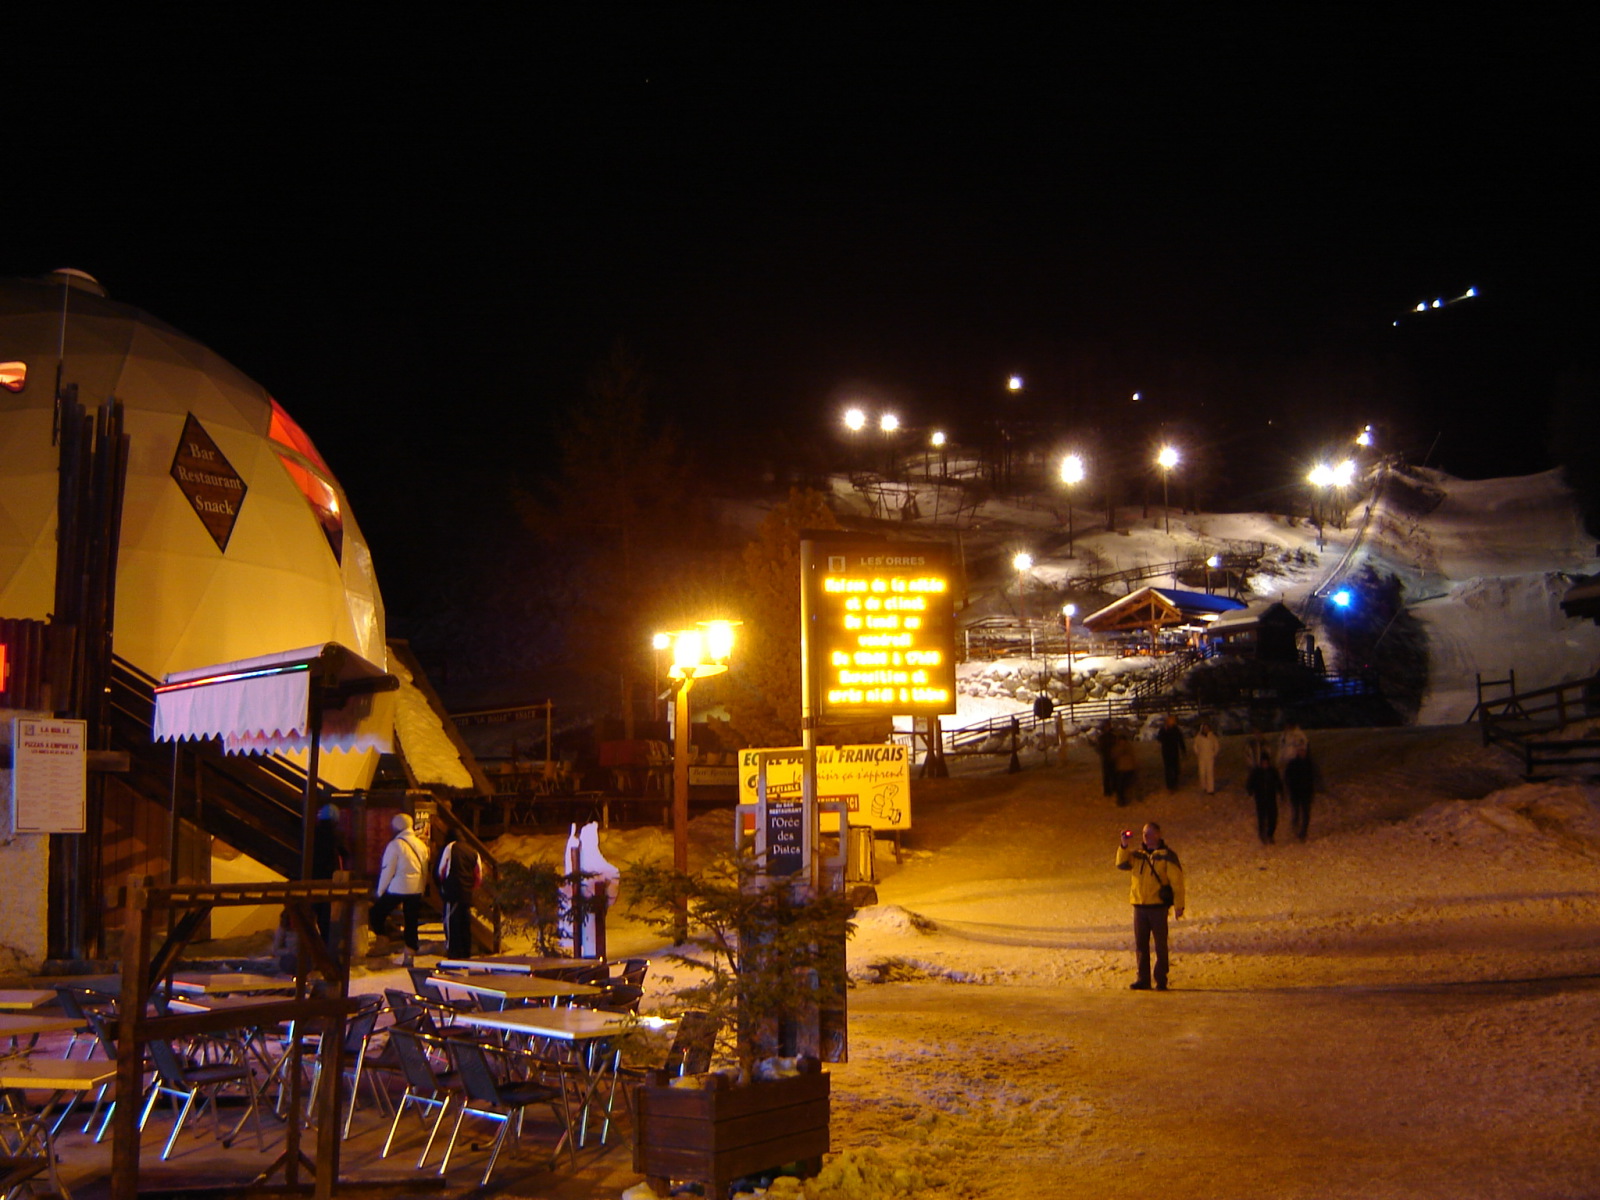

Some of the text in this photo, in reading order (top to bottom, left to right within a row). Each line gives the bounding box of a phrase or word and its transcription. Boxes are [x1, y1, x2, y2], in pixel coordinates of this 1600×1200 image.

[188, 442, 215, 461] Bar
[178, 465, 242, 490] Restaurant
[195, 495, 235, 516] Snack
[860, 556, 925, 566] LES ORRES
[837, 747, 904, 766] FRANÇAIS
[857, 766, 904, 783] s'apprend
[769, 807, 802, 815] RESTAURANT
[771, 816, 800, 828] l'Orée
[777, 830, 794, 841] des
[773, 844, 801, 855] Pistes
